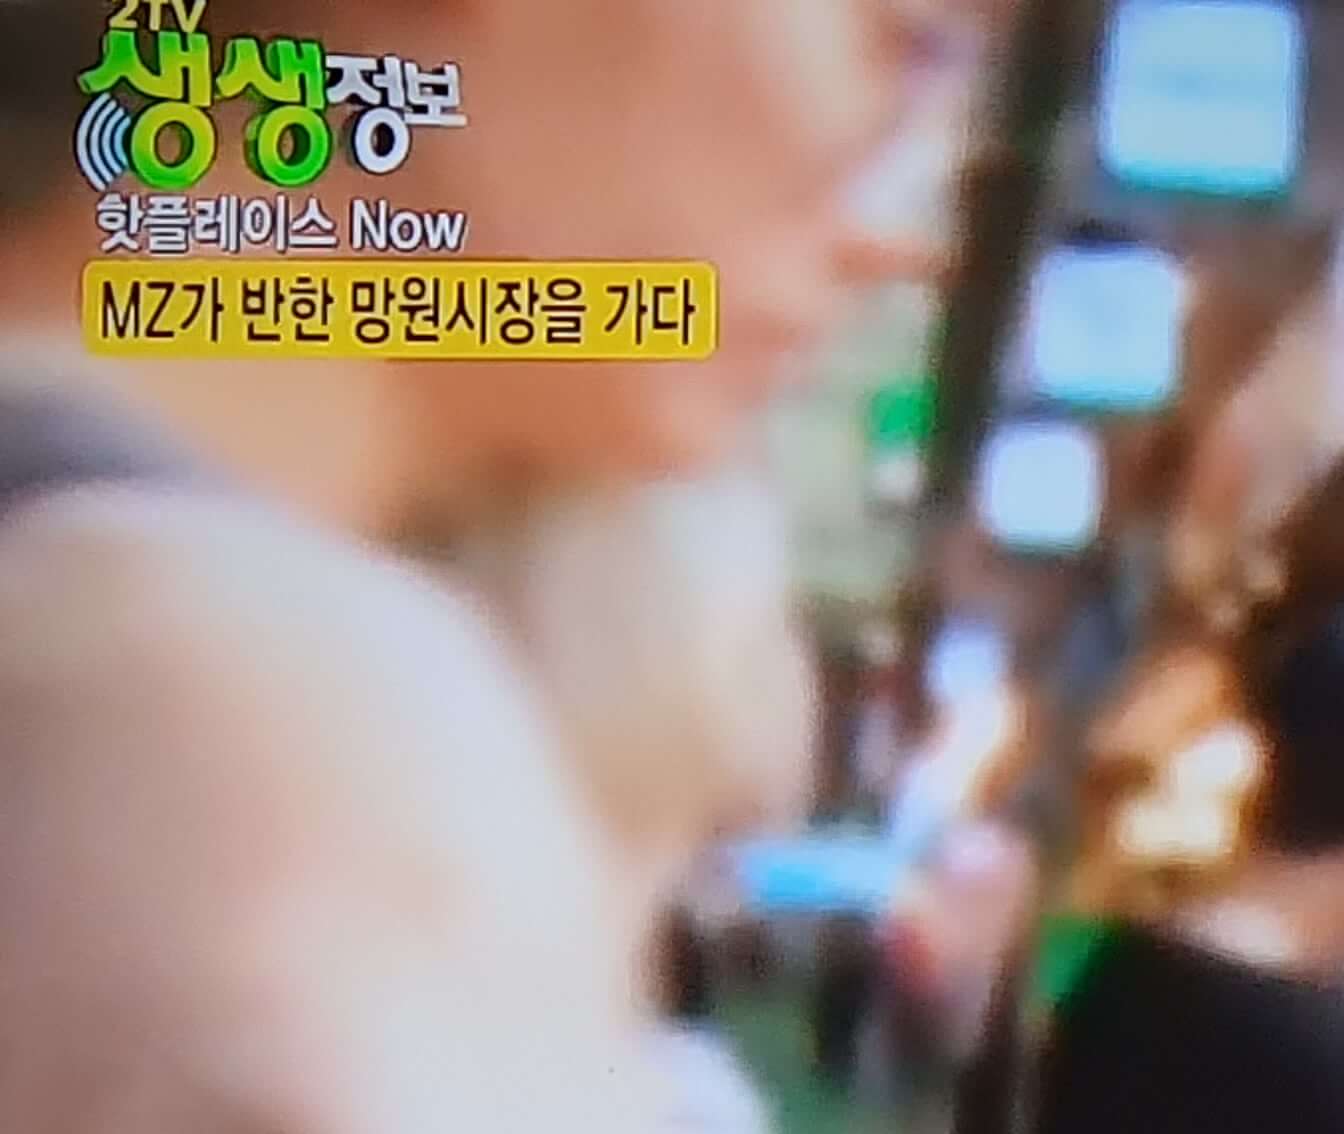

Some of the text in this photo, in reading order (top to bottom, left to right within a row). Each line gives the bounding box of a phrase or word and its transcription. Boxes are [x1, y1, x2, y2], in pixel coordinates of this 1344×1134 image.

[108, 0, 207, 33] 2TV
[97, 195, 466, 253] 핫플레이스 Now
[102, 277, 695, 345] MZ가 반한 망원시장을 가다
